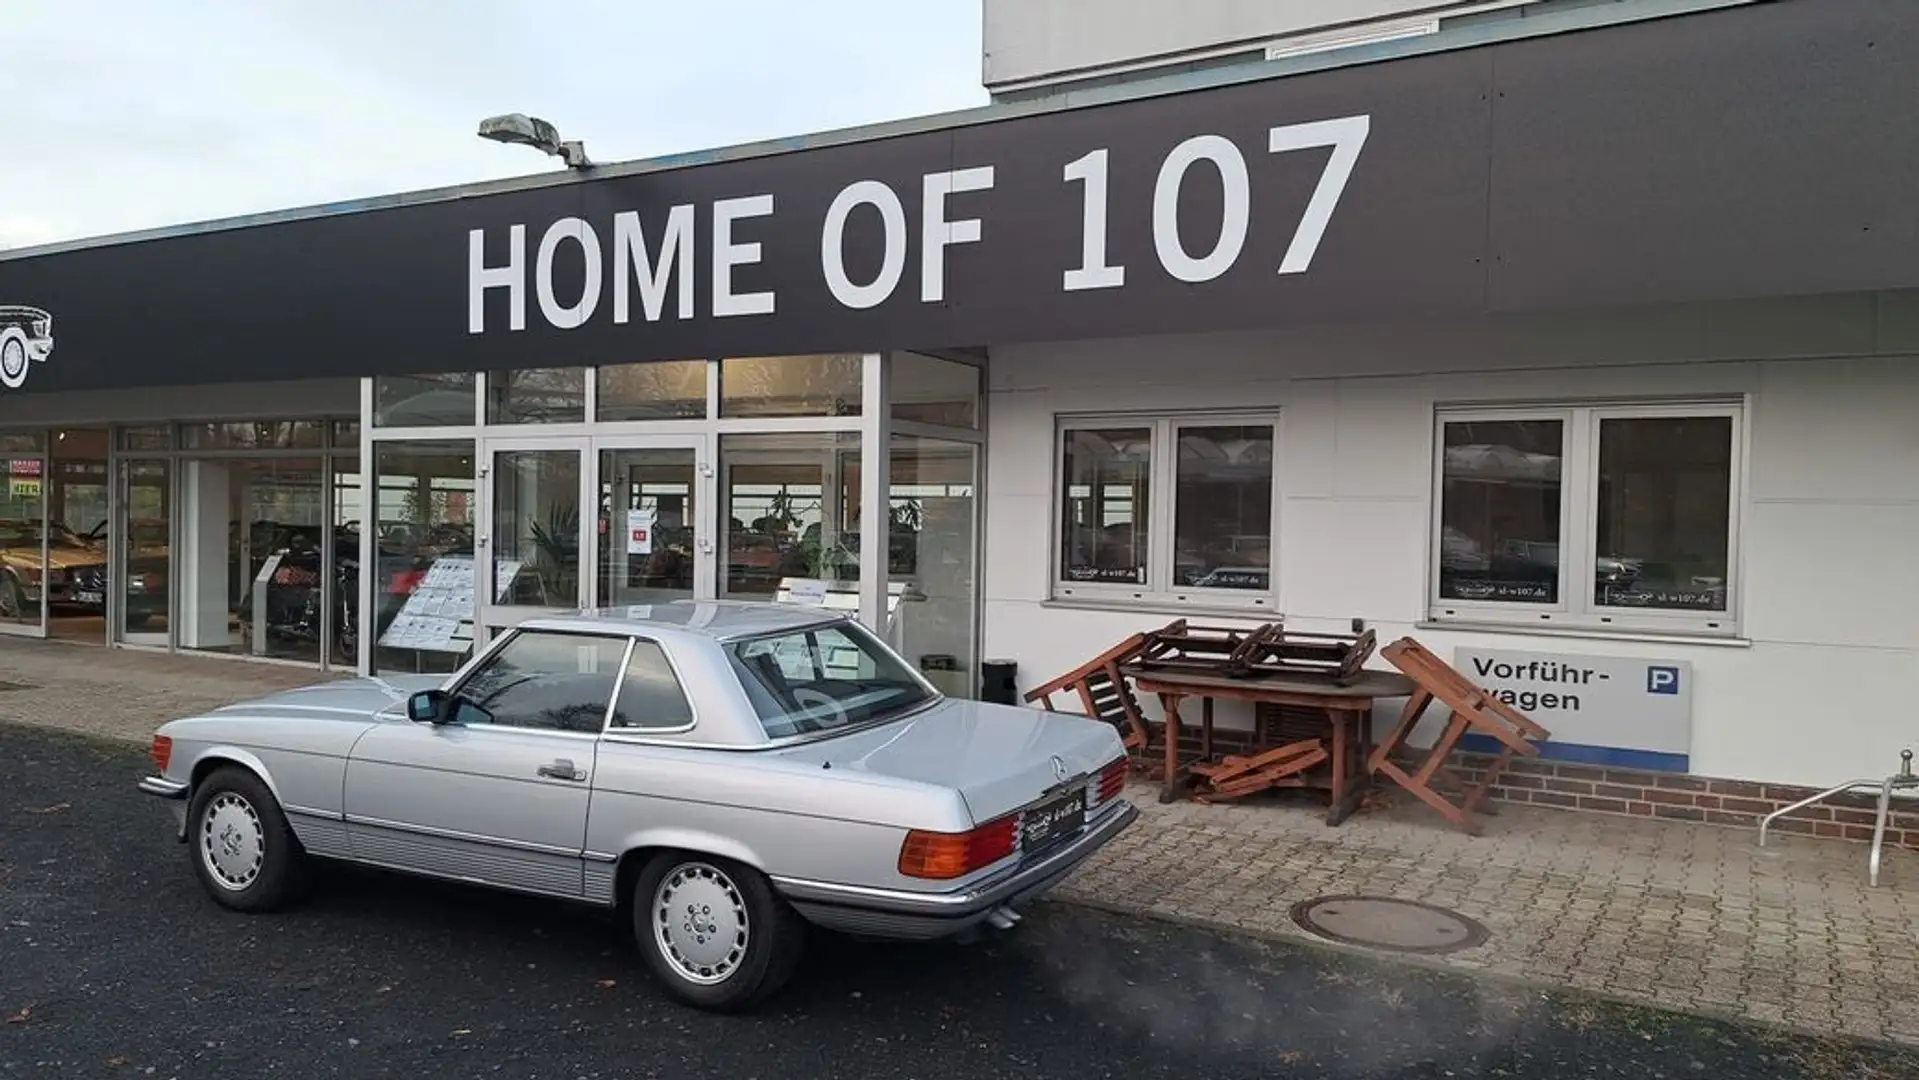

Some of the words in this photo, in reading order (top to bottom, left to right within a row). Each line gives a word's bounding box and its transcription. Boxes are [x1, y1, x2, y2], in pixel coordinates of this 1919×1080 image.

[467, 194, 776, 334] HOME
[821, 165, 995, 309] OF
[1060, 114, 1371, 292] 107
[1473, 656, 1610, 684] Vorführ-
[1652, 669, 1674, 690] P
